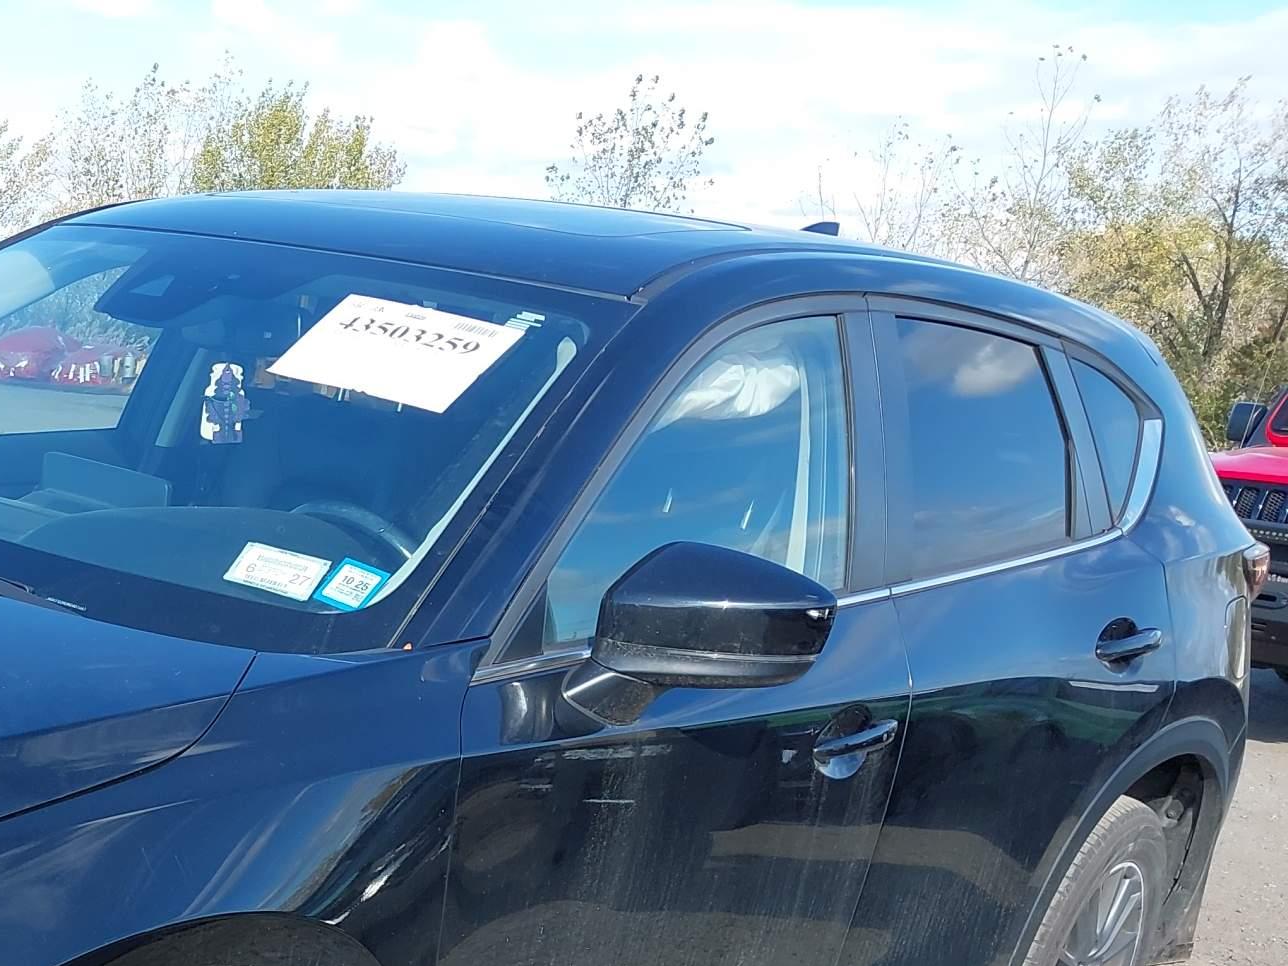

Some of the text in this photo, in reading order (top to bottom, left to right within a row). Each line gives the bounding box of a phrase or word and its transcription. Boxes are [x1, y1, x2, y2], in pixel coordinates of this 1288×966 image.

[339, 316, 480, 354] 43503259
[246, 563, 257, 573] 6
[288, 573, 312, 586] 27
[342, 575, 371, 591] 10 25
